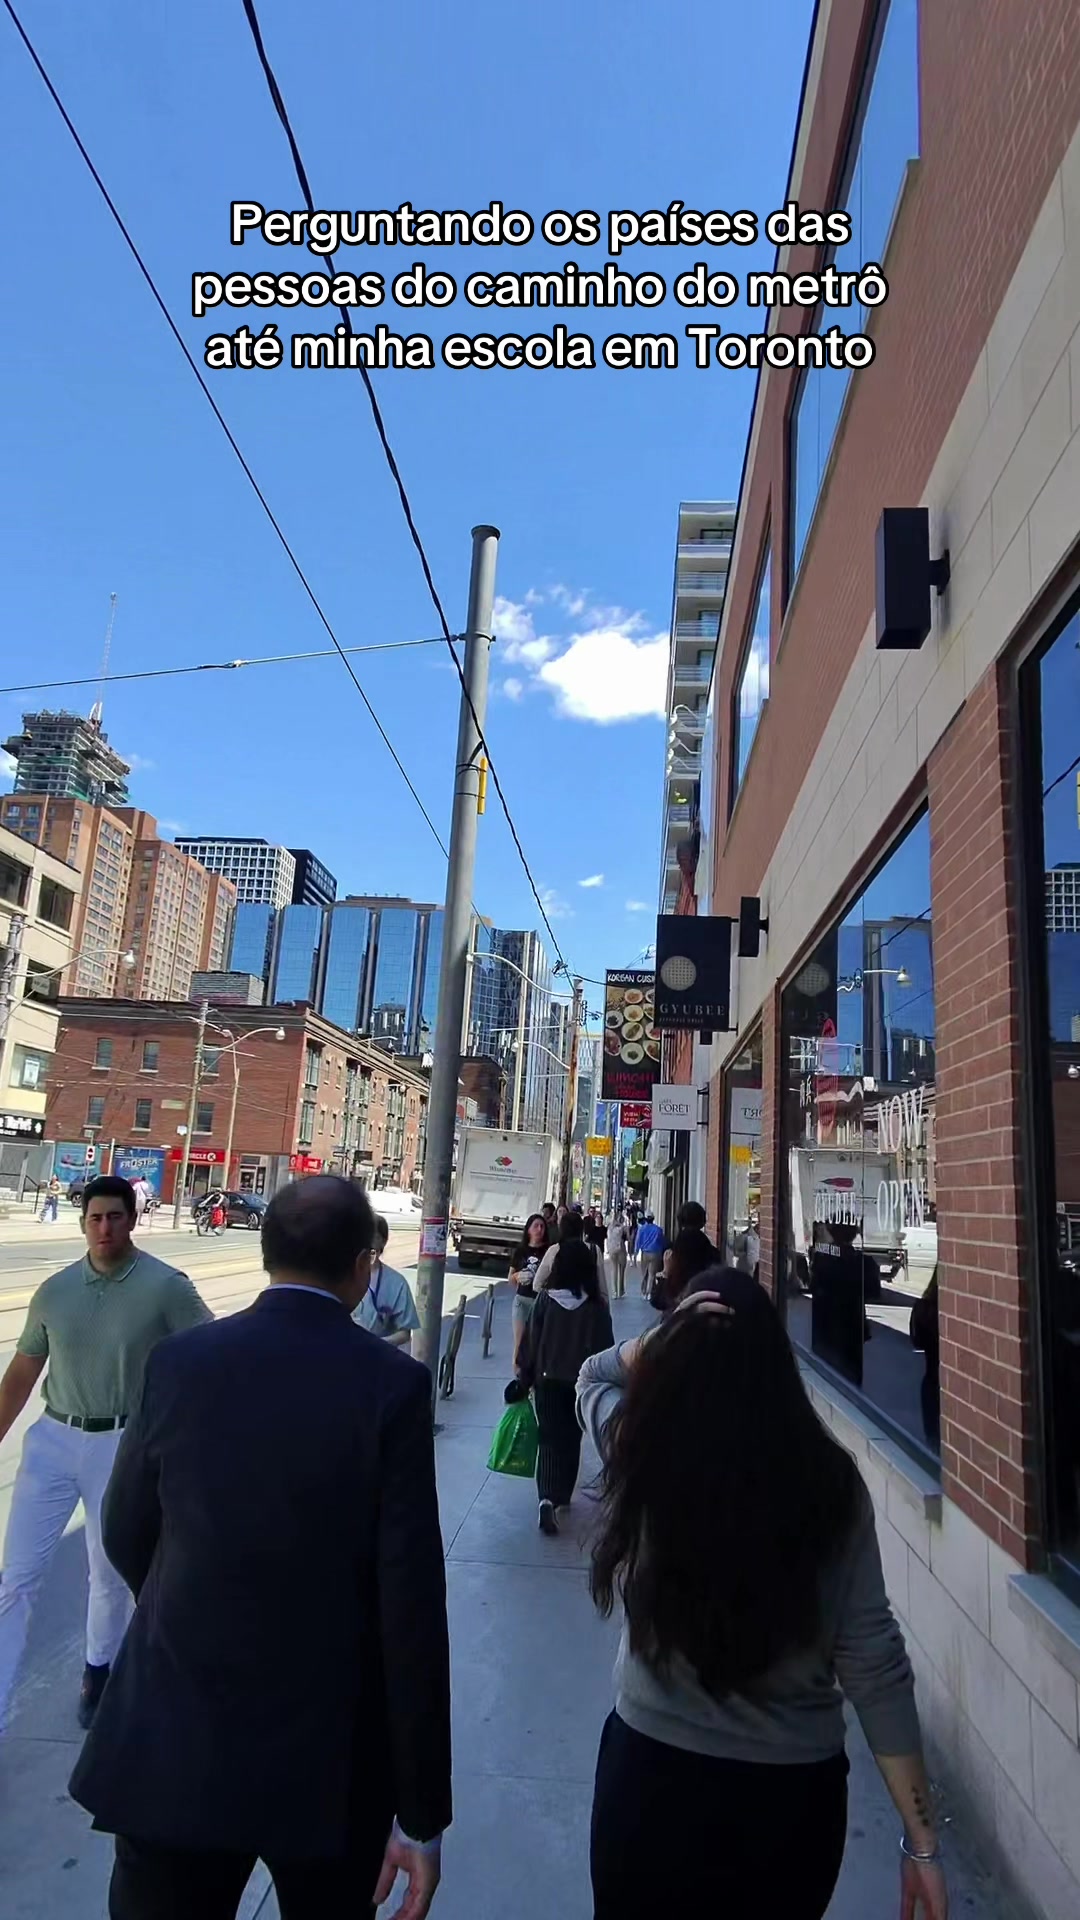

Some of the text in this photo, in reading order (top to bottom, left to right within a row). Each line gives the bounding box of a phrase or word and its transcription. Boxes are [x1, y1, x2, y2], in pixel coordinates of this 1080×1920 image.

[607, 973, 635, 983] KOREAN
[659, 1003, 725, 1016] GYUBEE
[877, 1086, 925, 1154] NOW
[877, 1178, 925, 1233] OPEN
